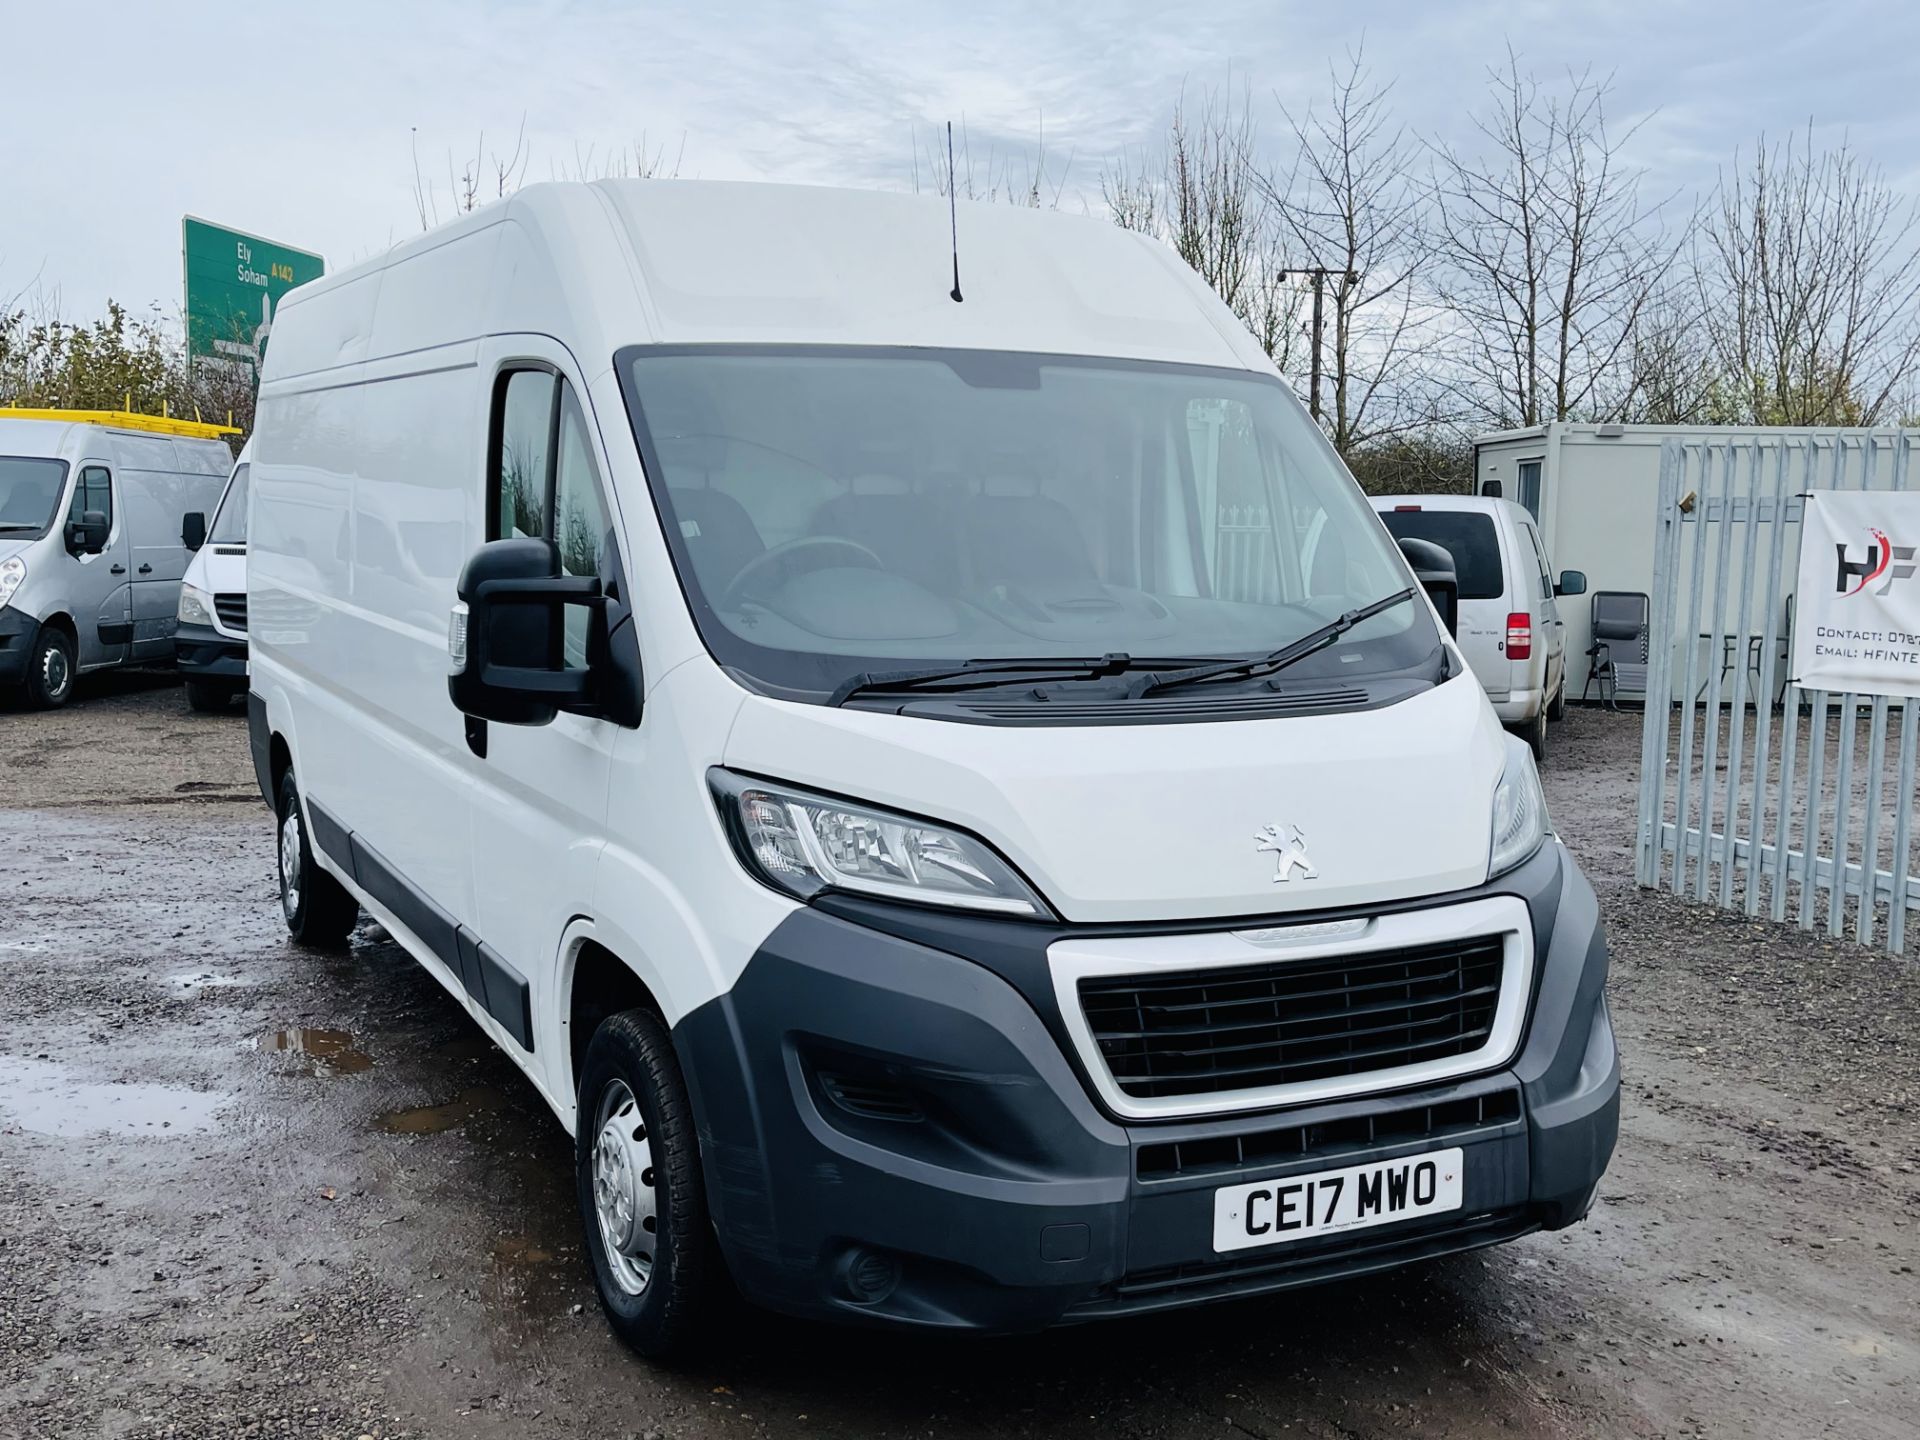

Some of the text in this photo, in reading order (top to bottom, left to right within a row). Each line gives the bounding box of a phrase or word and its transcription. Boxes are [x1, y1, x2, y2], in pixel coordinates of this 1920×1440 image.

[237, 242, 252, 265] Ely
[237, 264, 268, 287] Soham
[271, 262, 293, 284] A142
[1816, 626, 1882, 642] CONTACT:
[1815, 644, 1919, 664] EMAIL: HFINTE
[1257, 922, 1353, 940] PEUGEOT
[1245, 1160, 1436, 1236] CE17 MWO
